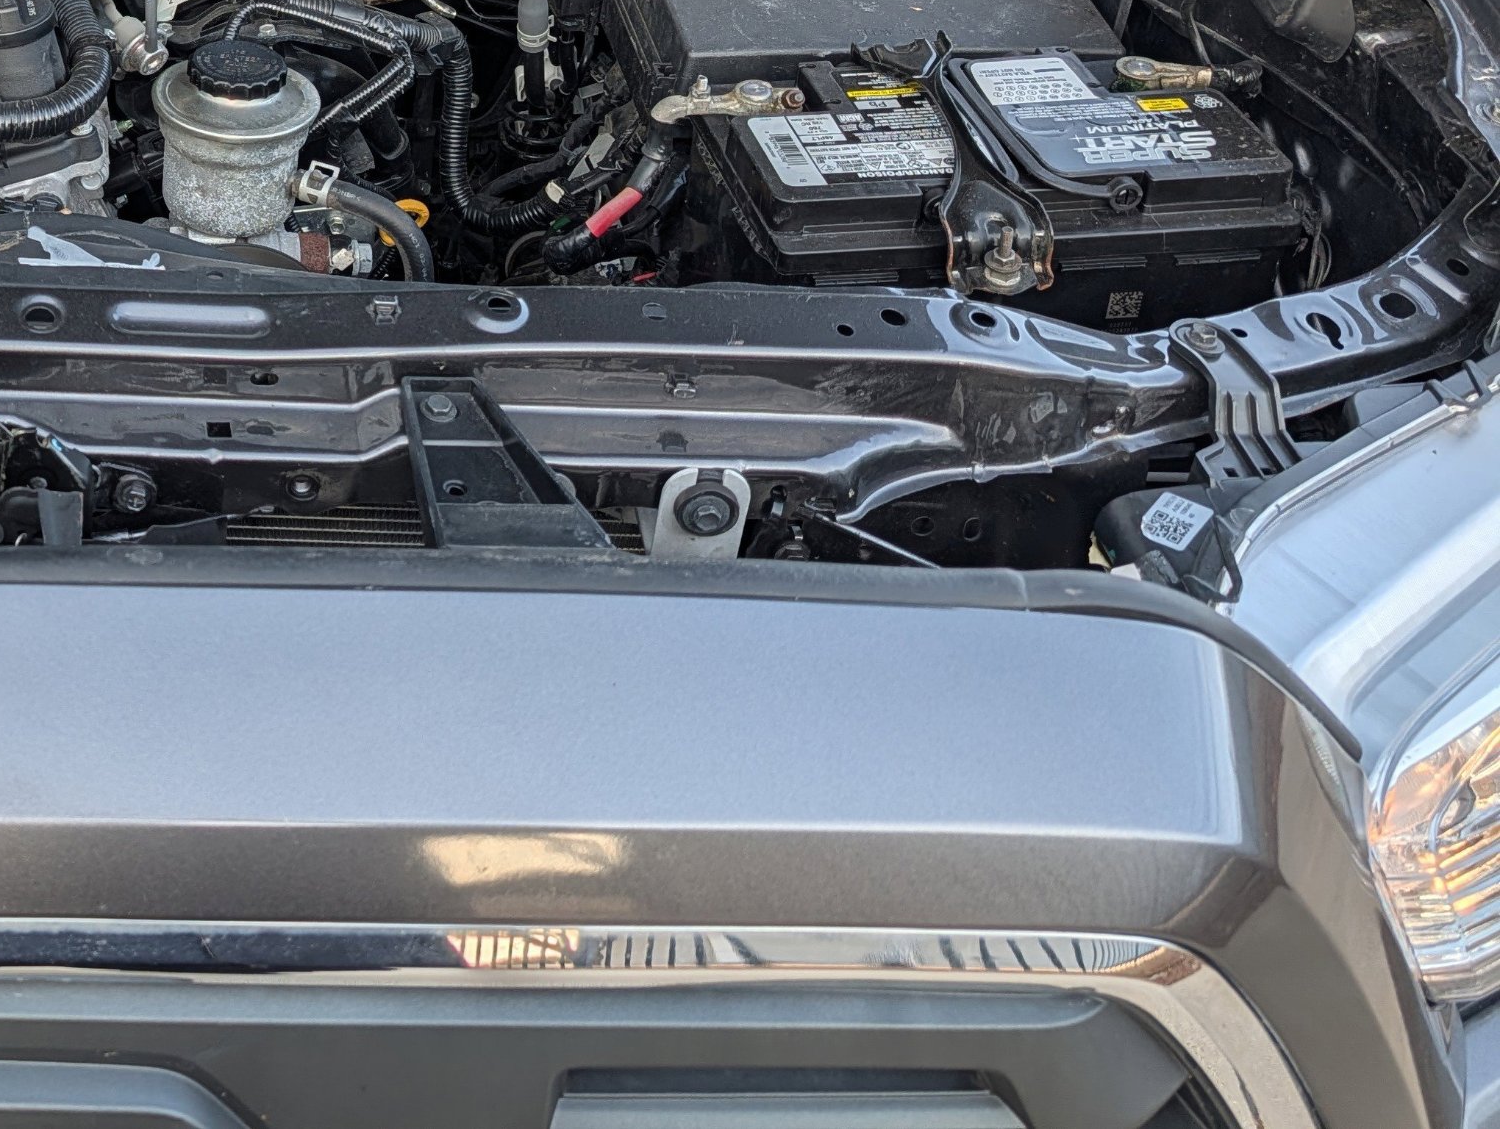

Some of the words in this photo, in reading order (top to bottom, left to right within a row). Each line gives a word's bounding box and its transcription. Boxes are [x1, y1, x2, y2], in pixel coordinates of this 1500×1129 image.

[1085, 119, 1200, 134] PLATINUM
[1084, 130, 1217, 150] START
[1082, 146, 1212, 164] SUPER
[857, 167, 954, 178] DANGER/POISON
